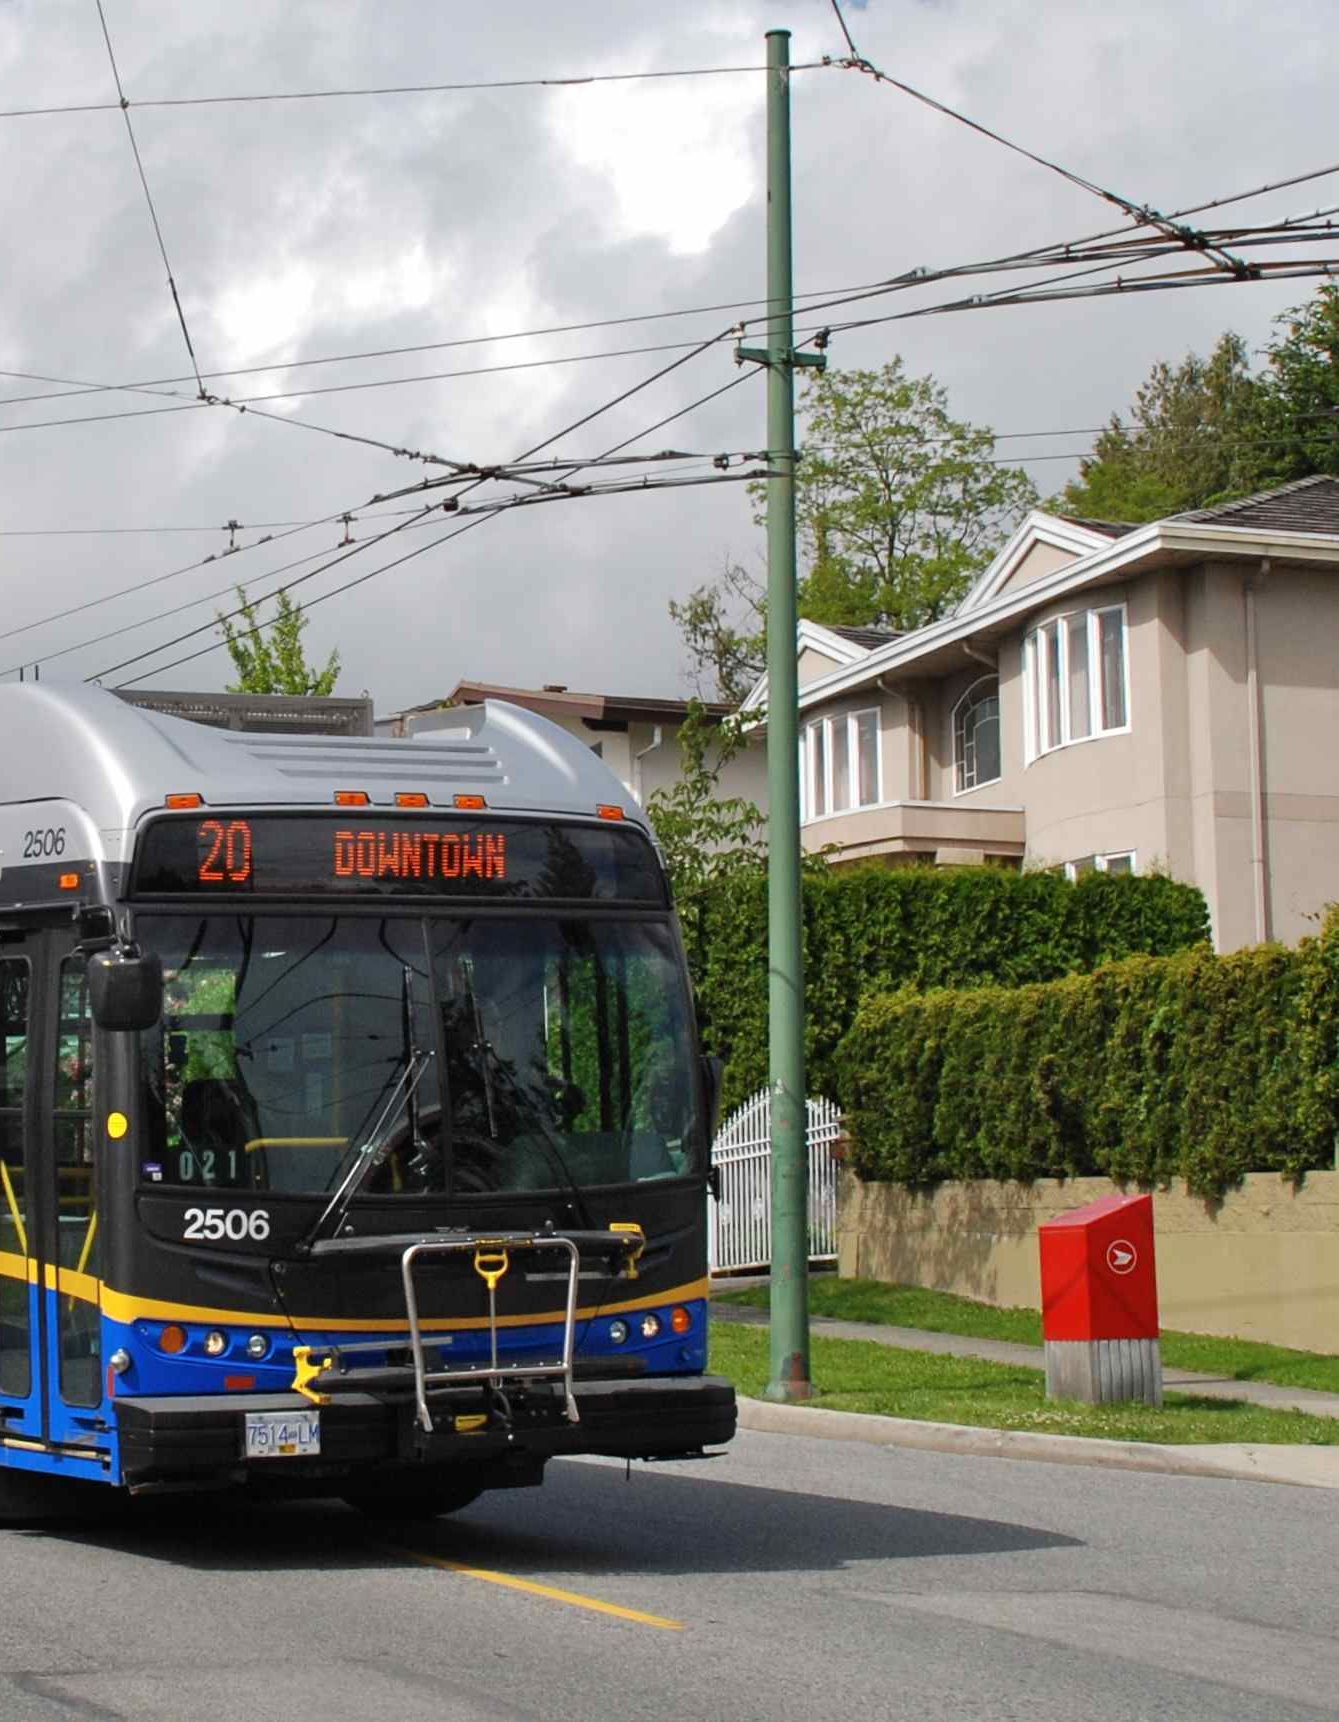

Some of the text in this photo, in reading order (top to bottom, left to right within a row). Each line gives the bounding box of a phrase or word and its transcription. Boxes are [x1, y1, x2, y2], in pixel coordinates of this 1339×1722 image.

[23, 828, 66, 859] 2506
[199, 820, 507, 881] 20 DOWNTOWN
[183, 1207, 270, 1240] 2506
